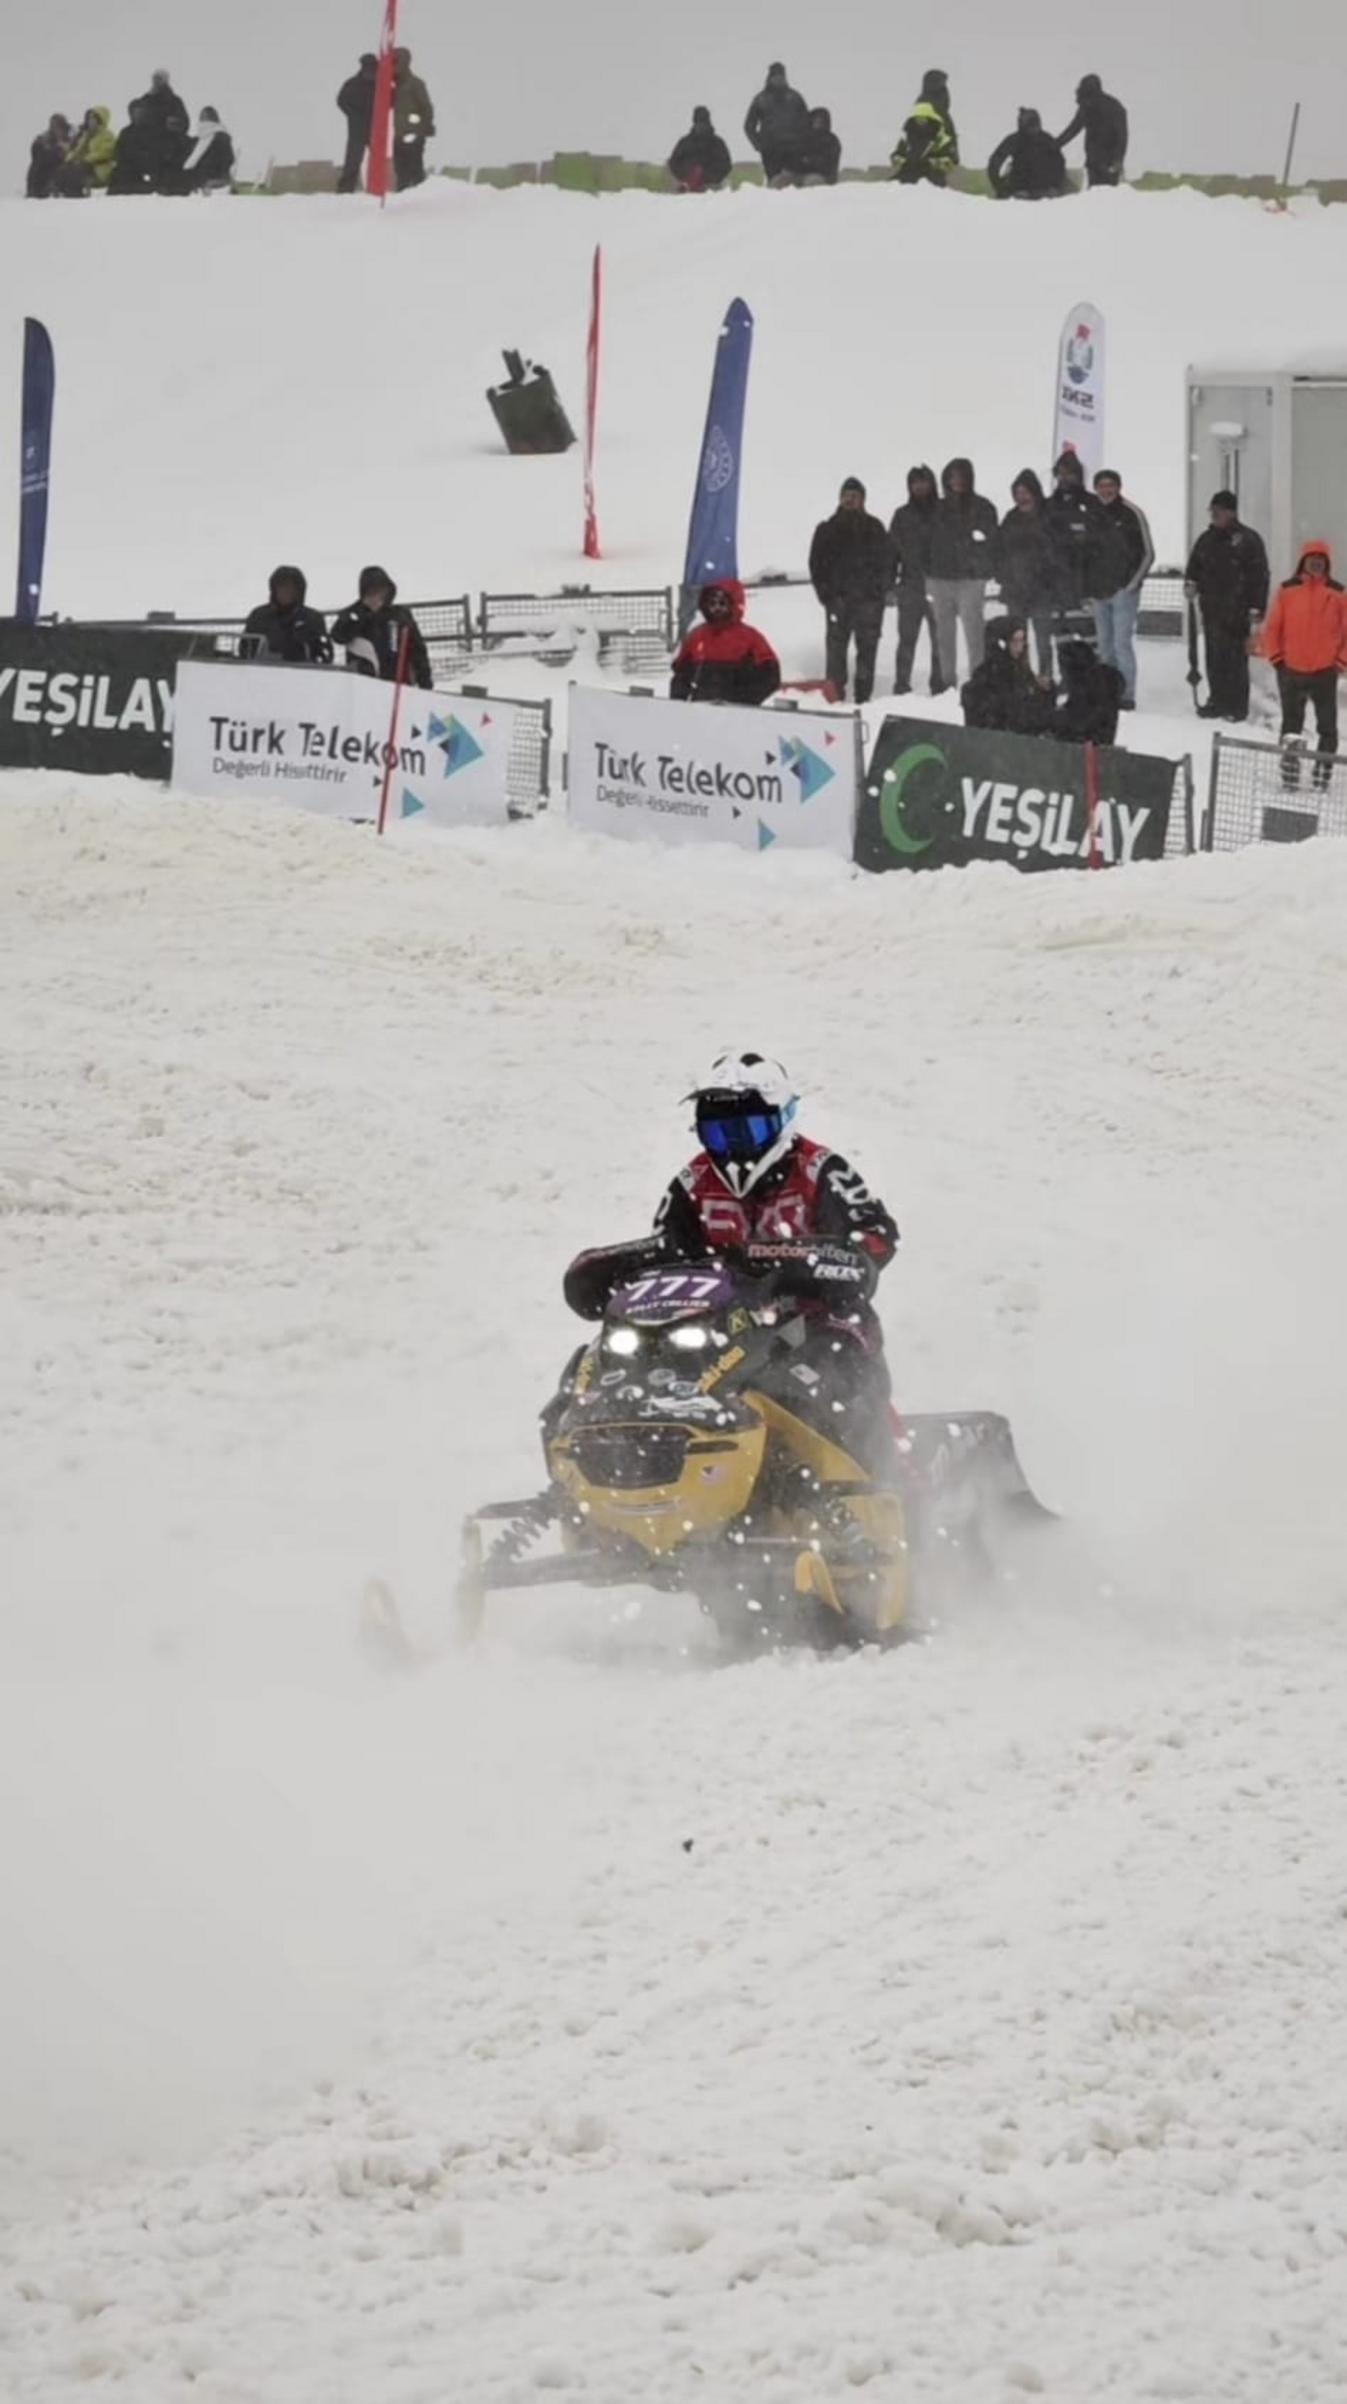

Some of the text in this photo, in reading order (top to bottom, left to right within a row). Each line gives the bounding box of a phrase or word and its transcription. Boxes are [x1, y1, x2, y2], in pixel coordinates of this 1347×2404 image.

[209, 716, 426, 776] Türk Telekom
[658, 755, 783, 804] Telekom
[624, 1275, 721, 1302] 777
